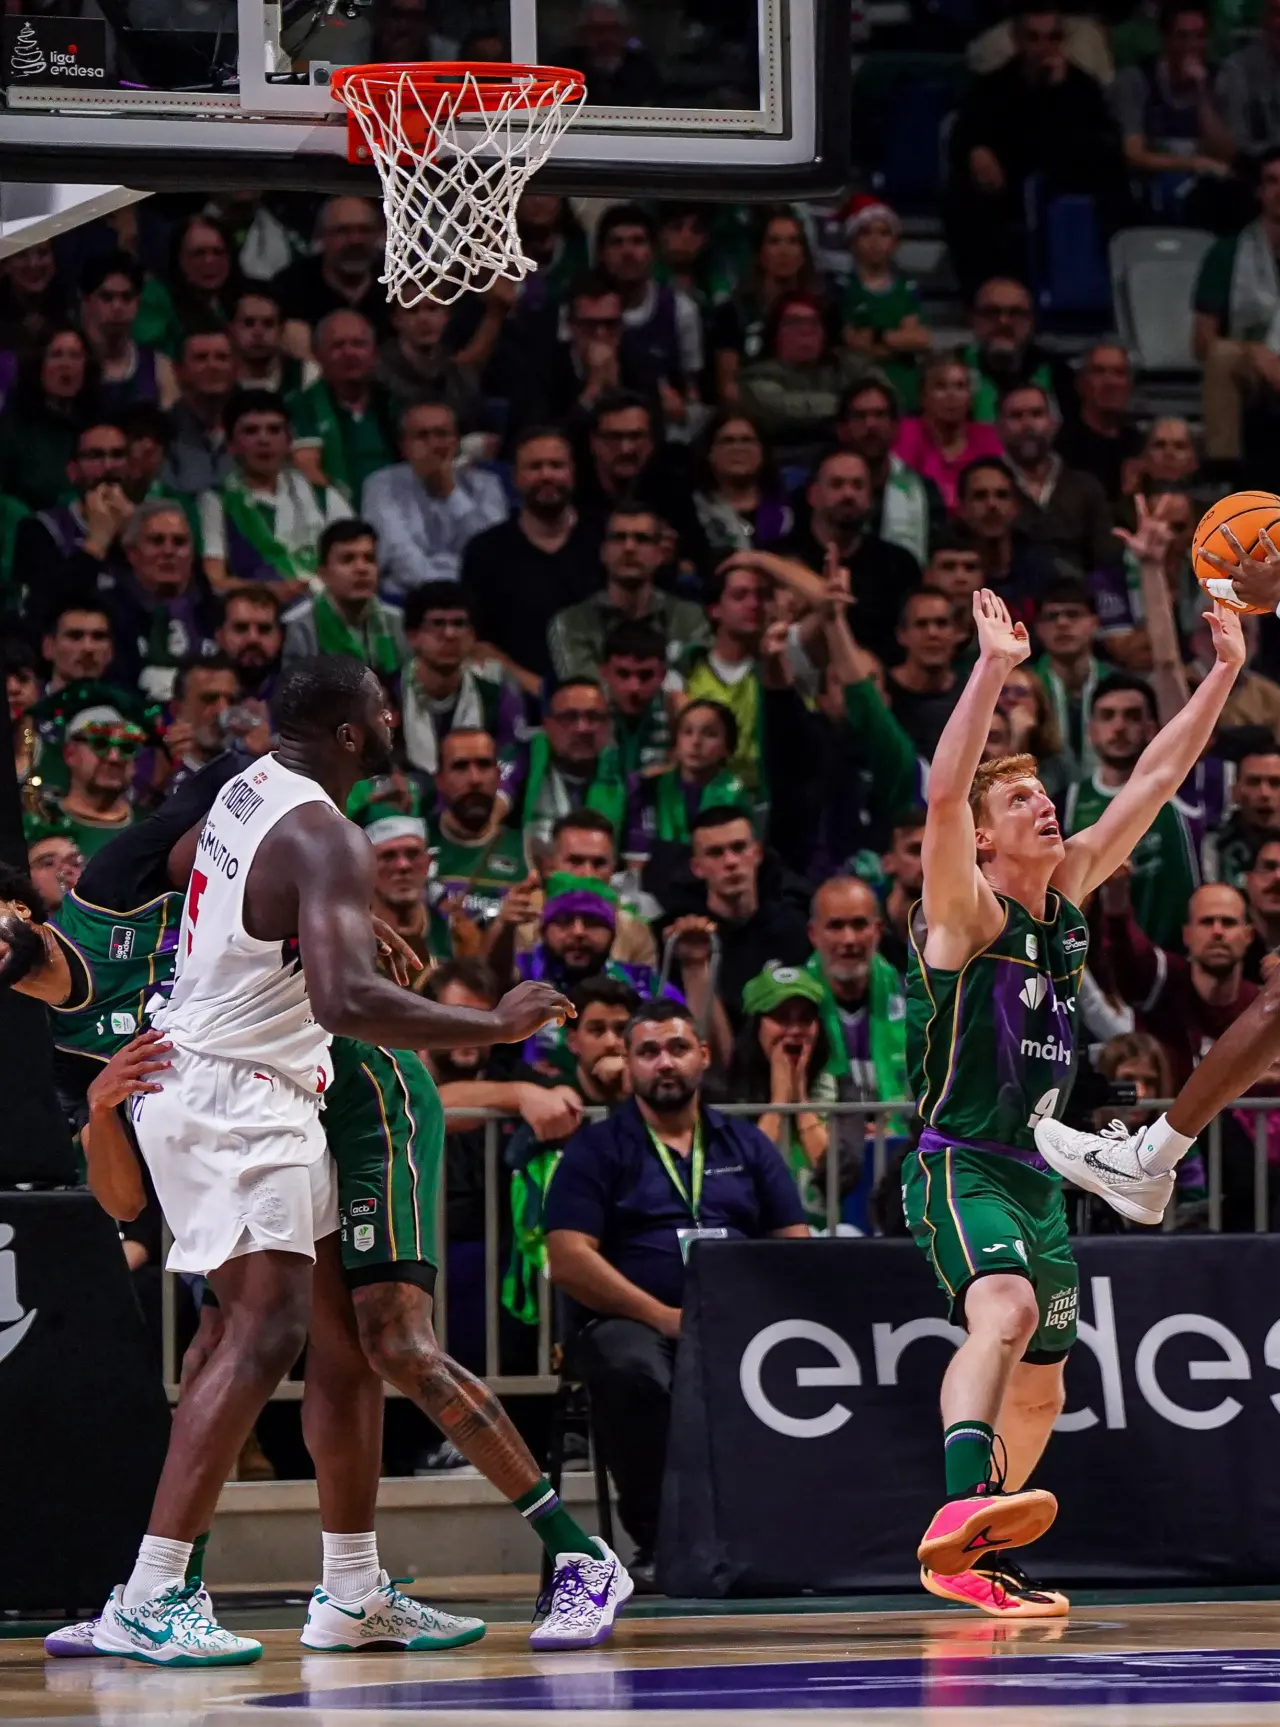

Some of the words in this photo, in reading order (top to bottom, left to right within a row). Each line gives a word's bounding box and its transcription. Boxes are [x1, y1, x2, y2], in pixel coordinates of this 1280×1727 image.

[50, 51, 75, 65] liga
[50, 65, 104, 78] endesa
[198, 828, 239, 880] AMUTIO
[352, 1205, 370, 1214] acb
[1044, 1308, 1076, 1330] laga
